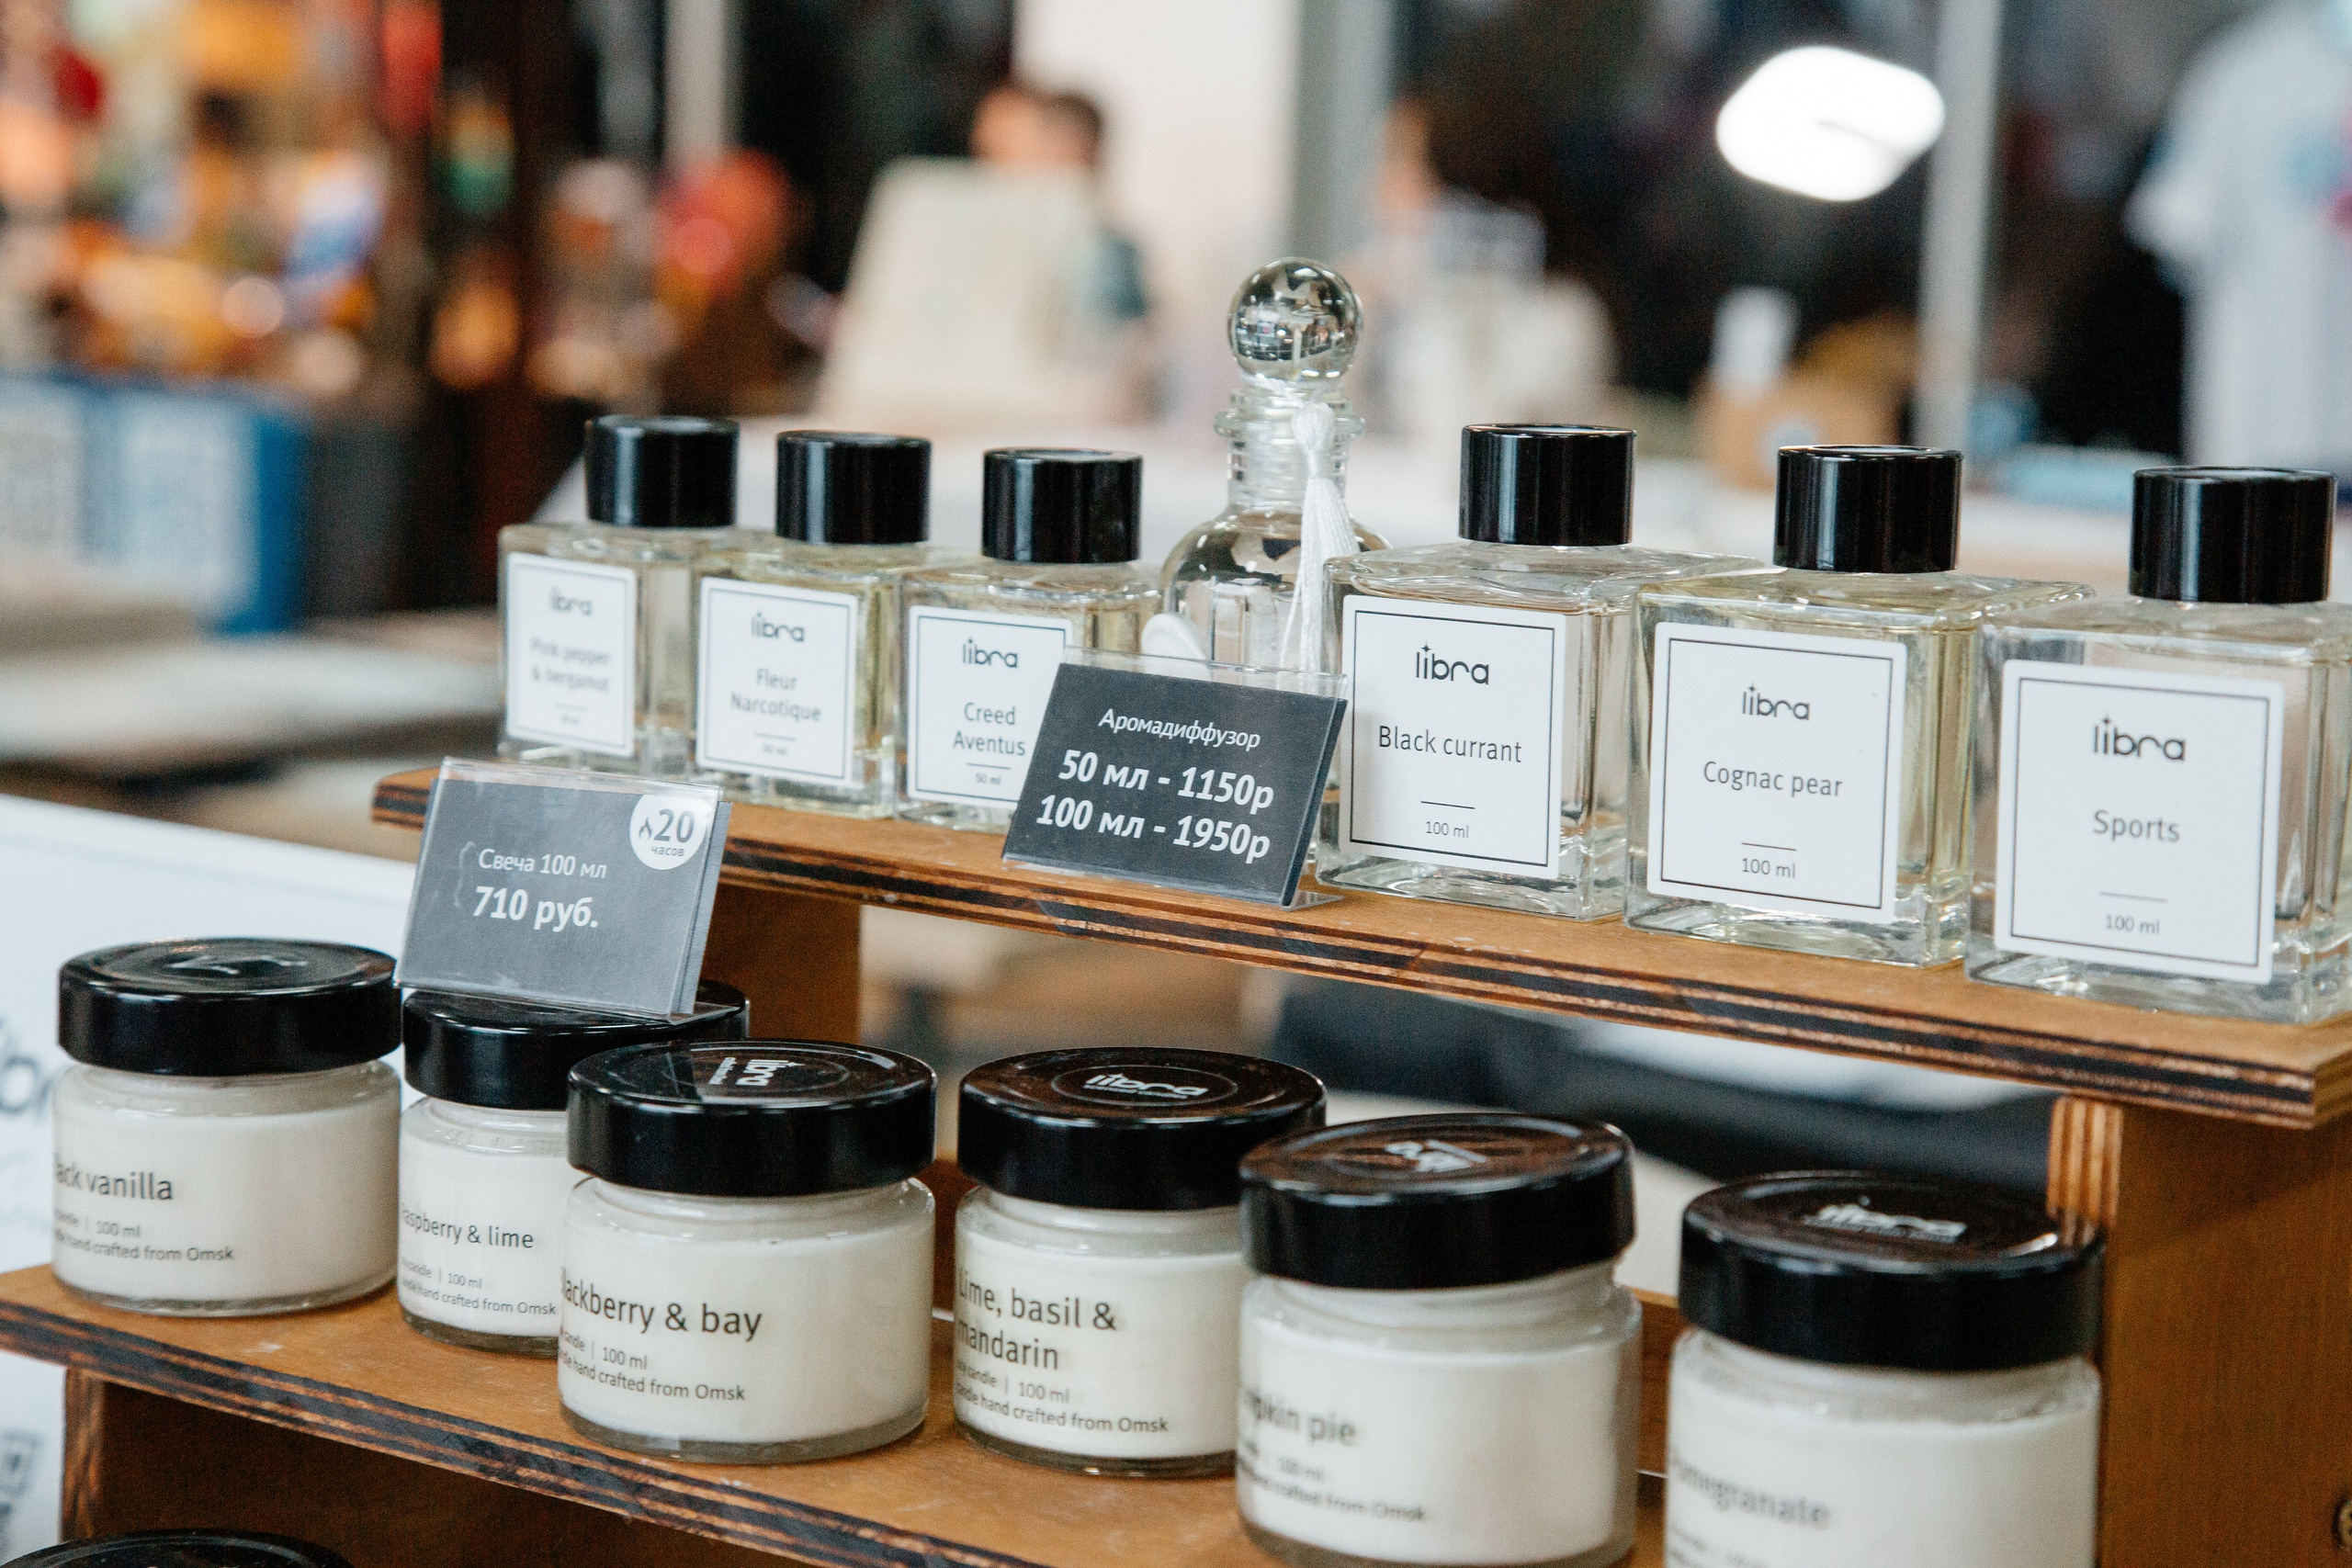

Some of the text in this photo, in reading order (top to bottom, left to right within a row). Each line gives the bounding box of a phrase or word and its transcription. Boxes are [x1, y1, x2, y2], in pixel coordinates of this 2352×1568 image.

[751, 611, 805, 642] libra
[962, 637, 1019, 669] libra
[1415, 640, 1490, 685] libra
[756, 668, 797, 690] Fleur
[731, 693, 821, 723] Narcotique
[964, 702, 1016, 726] Creed
[1742, 682, 1810, 721] libra
[953, 731, 1026, 757] Aventus
[1098, 708, 1261, 751] Аромадиффузор
[1379, 725, 1522, 763] Black currant
[2093, 711, 2186, 761] libra
[1058, 749, 1099, 782] 50
[1102, 764, 1149, 791] мл
[1177, 766, 1274, 815] 1150р
[1703, 761, 1843, 797] Cognac pear
[653, 808, 695, 843] 20
[1035, 795, 1093, 830] 100
[1098, 812, 1146, 839] мл
[1172, 816, 1272, 863] 1950р
[1425, 820, 1469, 839] 100 ml
[2093, 808, 2181, 842] Sports
[478, 848, 607, 879] Свеча 100 мл
[650, 844, 685, 857] часов
[1742, 858, 1796, 879] 100 ml
[472, 885, 598, 932] 710 руб.
[2105, 915, 2160, 935] 100 ml
[1085, 1073, 1209, 1096] libra
[55, 1152, 173, 1201] ack vanilla
[96, 1220, 119, 1236] 100
[401, 1207, 534, 1248] aspberry & lime
[143, 1244, 182, 1261] from
[186, 1246, 234, 1261] Omsk
[447, 1273, 466, 1287] 100
[442, 1292, 480, 1309] crafted
[482, 1298, 514, 1314] from
[517, 1301, 556, 1314] Omsk
[560, 1267, 763, 1343] lackberry & bay
[1012, 1287, 1080, 1328] basil
[1092, 1302, 1116, 1331] &
[603, 1346, 626, 1366] 100
[628, 1354, 648, 1370] ml
[957, 1319, 1058, 1371] mandarin
[598, 1371, 645, 1393] crafted
[650, 1378, 689, 1399] from
[695, 1383, 746, 1401] Omsk
[1019, 1381, 1046, 1400] 100
[1049, 1388, 1070, 1404] ml
[1013, 1406, 1067, 1427] crafted
[1070, 1413, 1113, 1431] from
[1118, 1416, 1169, 1434] Omsk
[1308, 1410, 1355, 1446] pie
